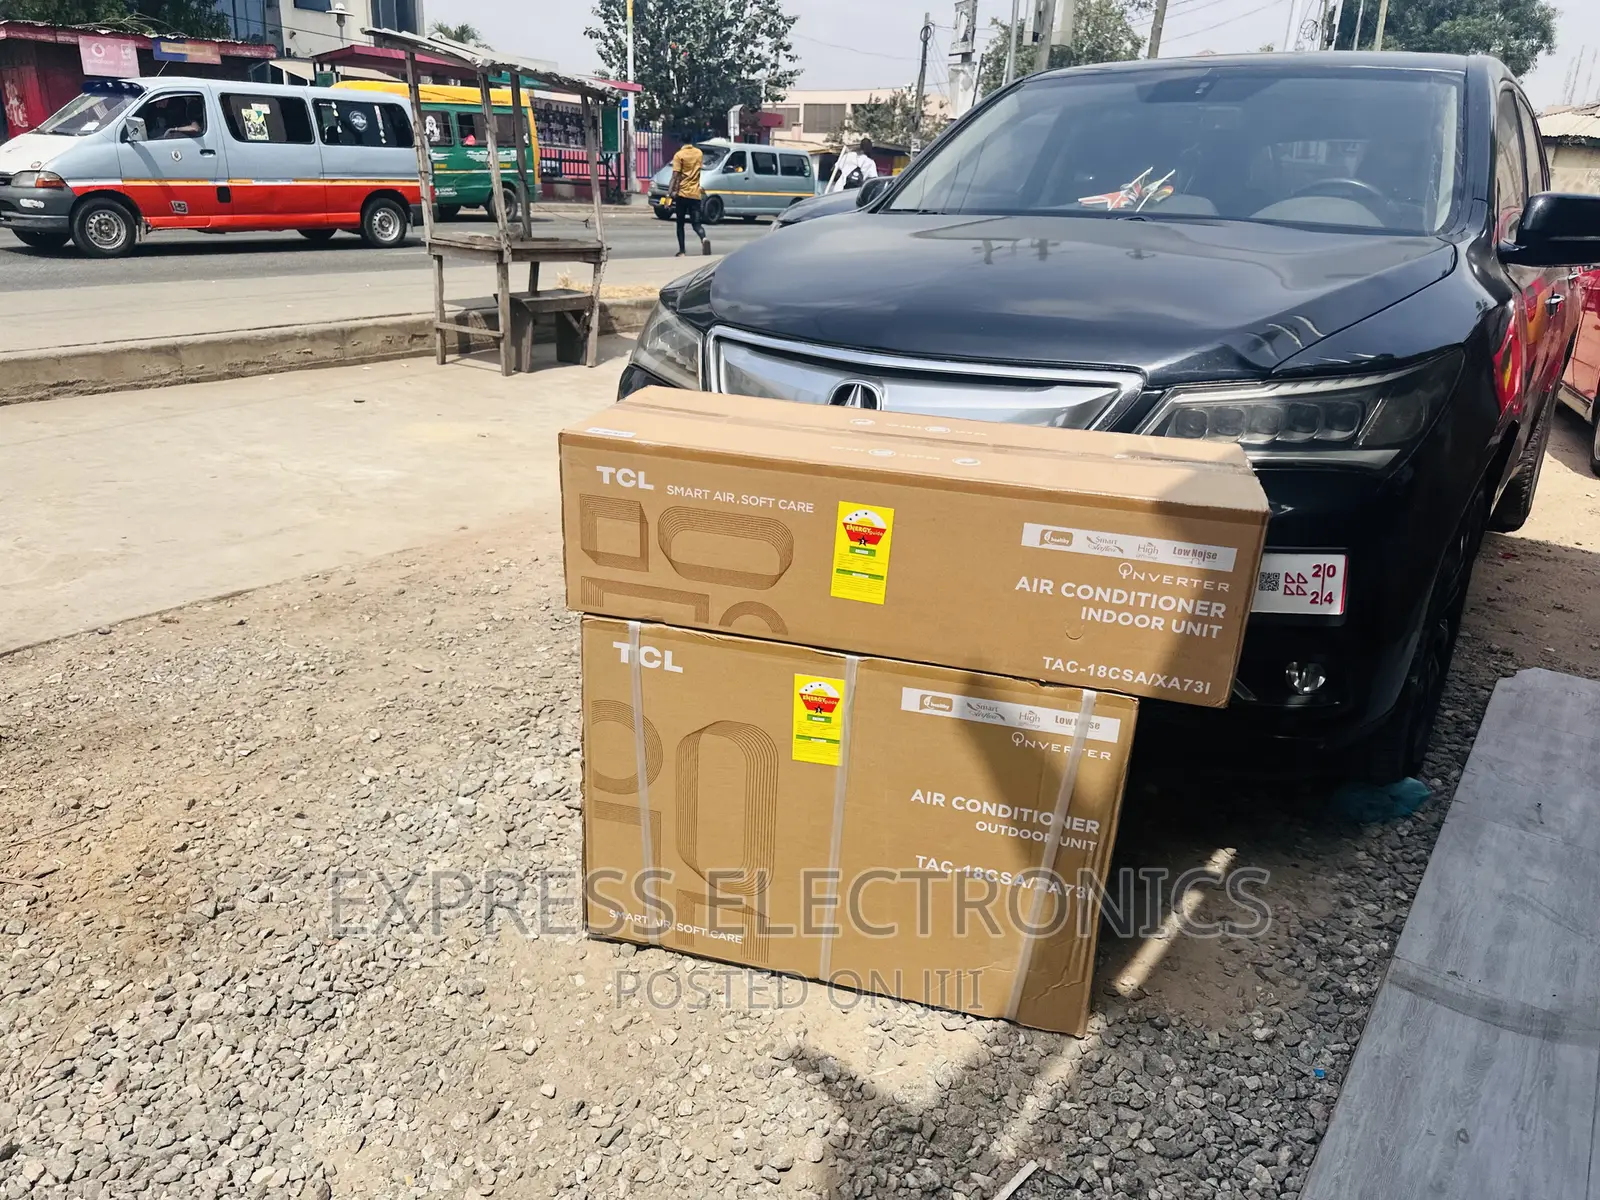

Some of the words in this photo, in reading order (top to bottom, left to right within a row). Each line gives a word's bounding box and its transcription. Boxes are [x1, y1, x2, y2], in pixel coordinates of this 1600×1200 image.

[596, 465, 654, 490] TCL
[667, 485, 710, 501] SMART
[778, 499, 814, 514] CARE
[846, 524, 872, 534] ENERGY
[1095, 535, 1118, 546] Smart
[1137, 543, 1159, 556] High
[1173, 546, 1191, 557] Low
[1015, 576, 1054, 595] AIR
[1060, 582, 1227, 619] CONDITIONER
[1081, 606, 1165, 631] INDOOR
[1171, 619, 1223, 639] UNIT
[613, 641, 684, 674] TCL
[974, 702, 999, 712] Smart
[1019, 711, 1041, 724] High
[1055, 715, 1074, 726] Low
[911, 789, 946, 808] AIR
[1060, 836, 1098, 851] UNIT
[609, 909, 649, 925] SMART
[710, 930, 743, 945] CARE
